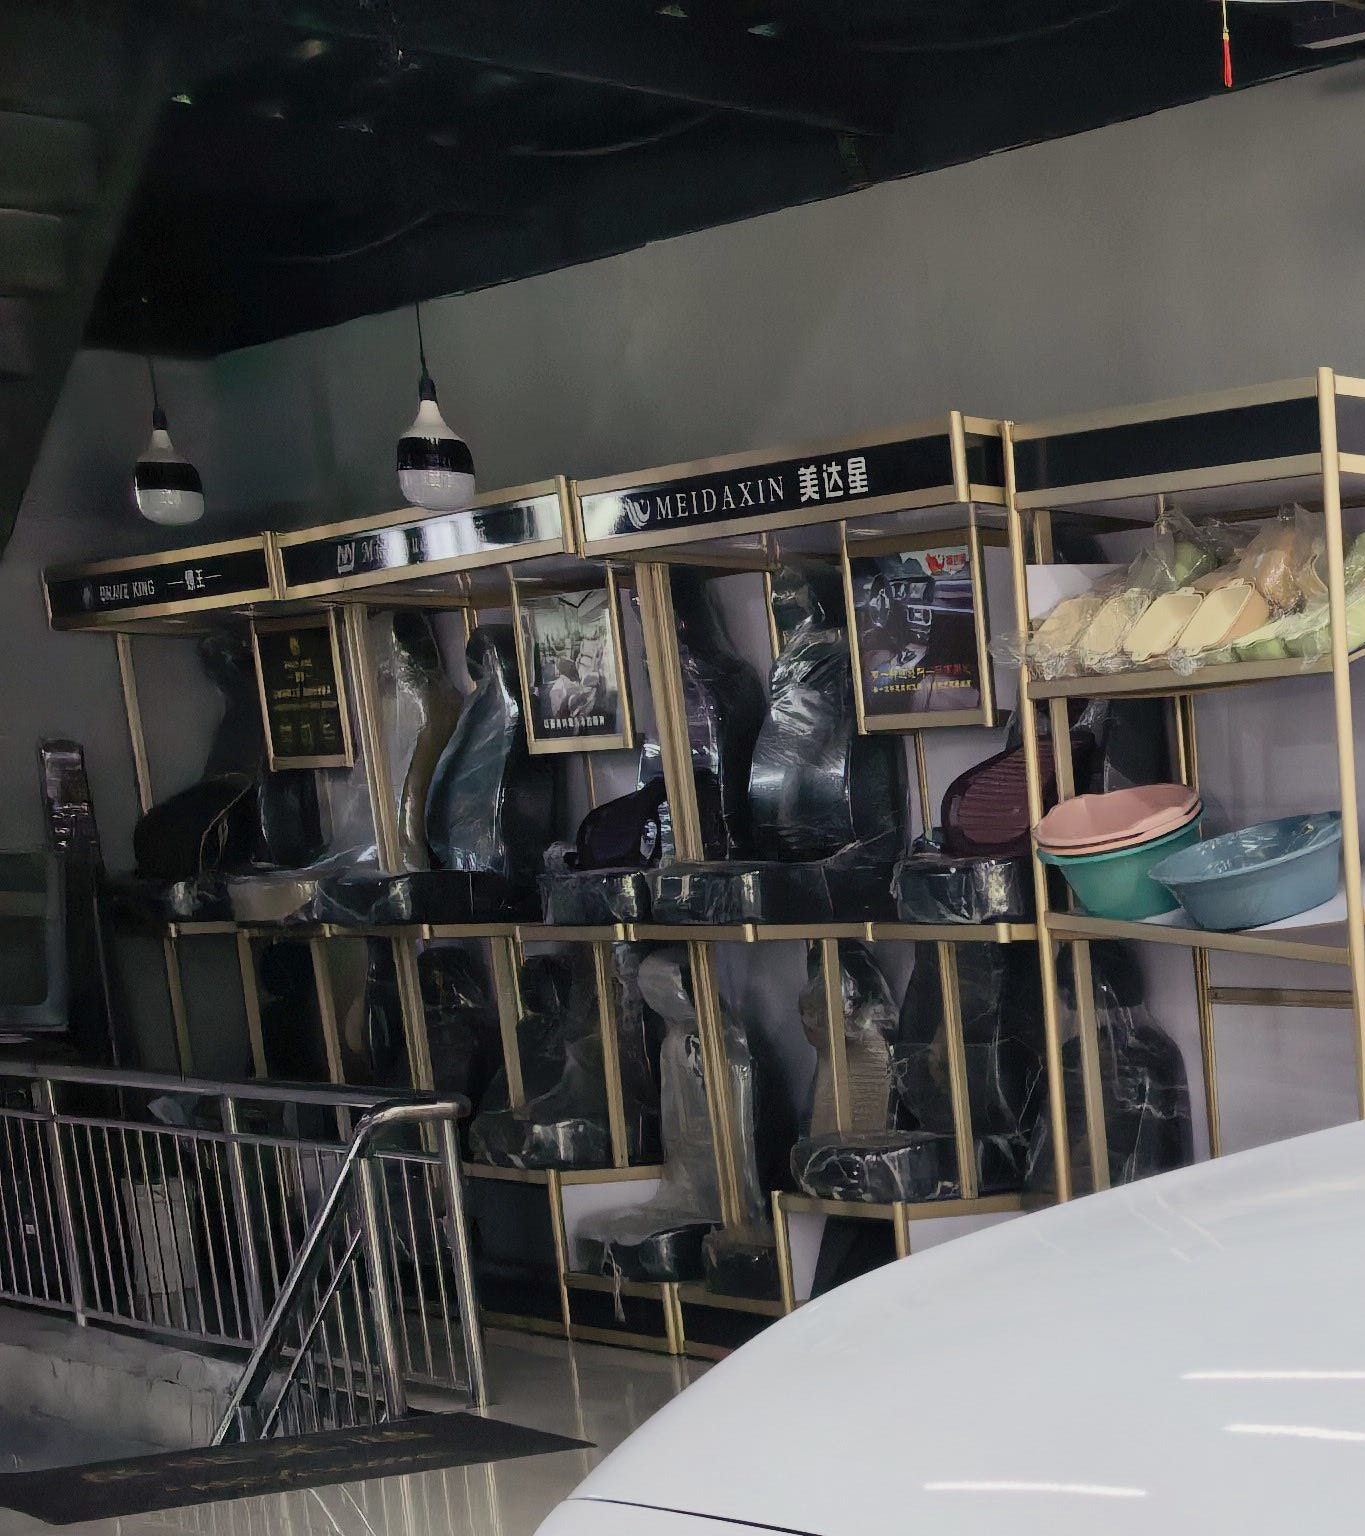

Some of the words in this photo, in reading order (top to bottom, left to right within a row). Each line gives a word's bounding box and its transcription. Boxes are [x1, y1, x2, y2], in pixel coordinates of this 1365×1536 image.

[655, 475, 784, 521] MEIDAXIN
[797, 456, 869, 504] 美达星
[131, 579, 155, 599] KING
